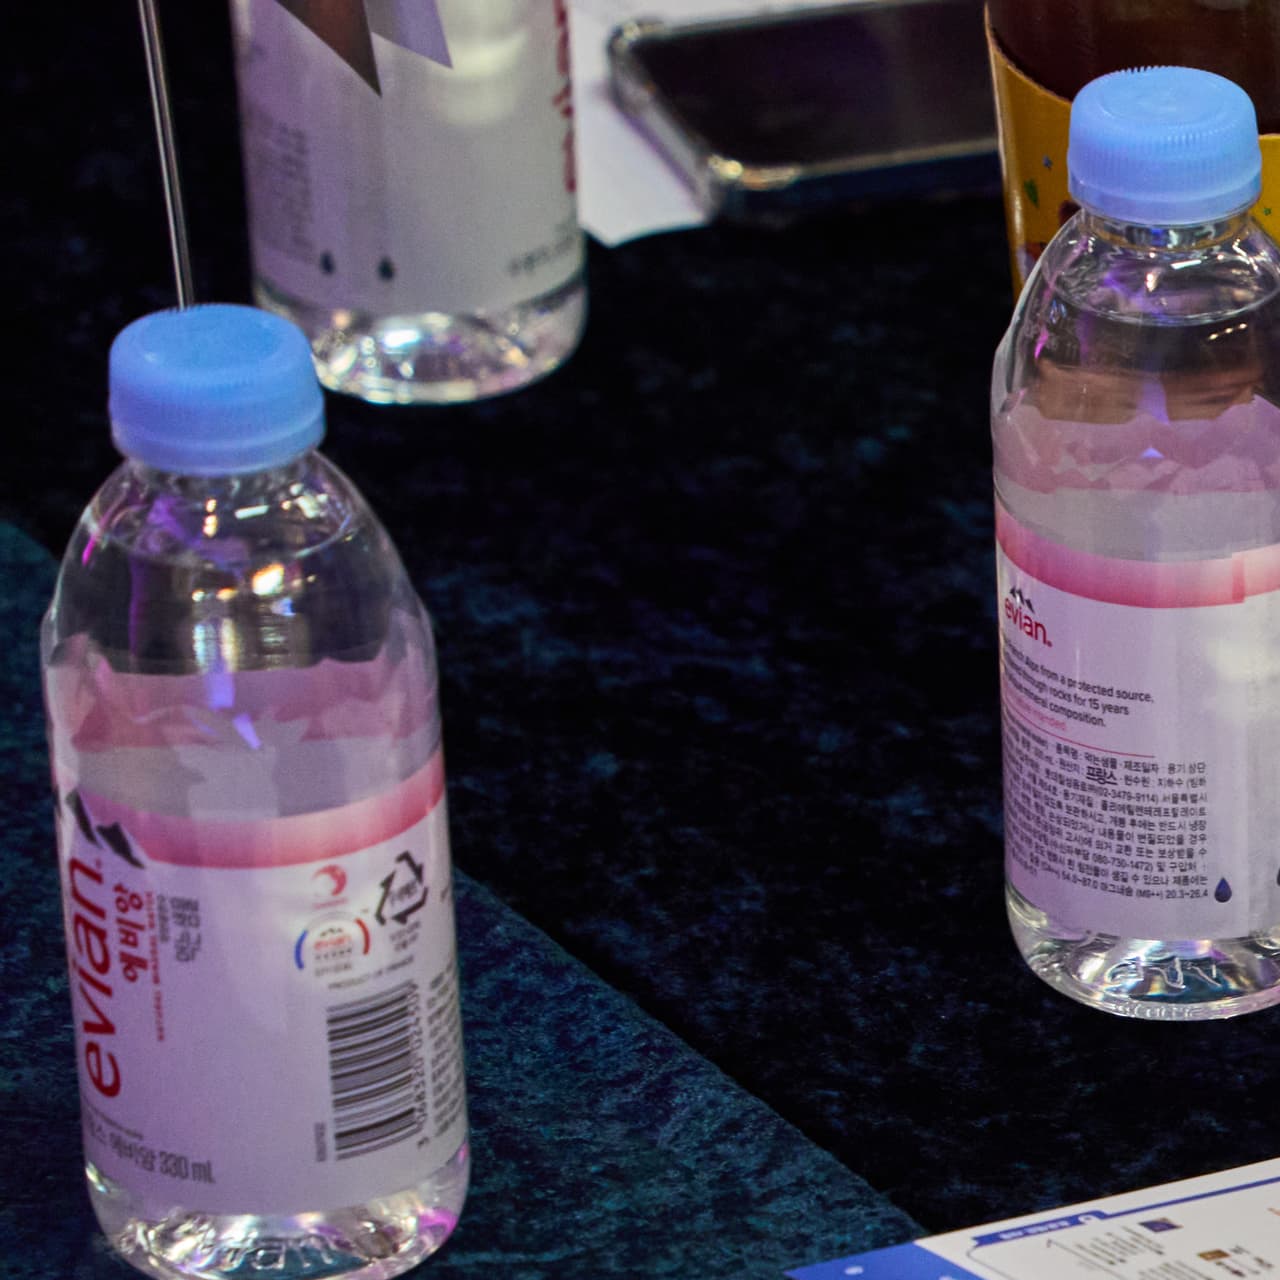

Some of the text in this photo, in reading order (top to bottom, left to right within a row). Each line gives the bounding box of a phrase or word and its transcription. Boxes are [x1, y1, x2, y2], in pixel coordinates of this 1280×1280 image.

[1088, 697, 1101, 712] 15
[1102, 701, 1130, 716] years
[69, 856, 122, 1099] evian
[113, 883, 150, 983] 에비앙
